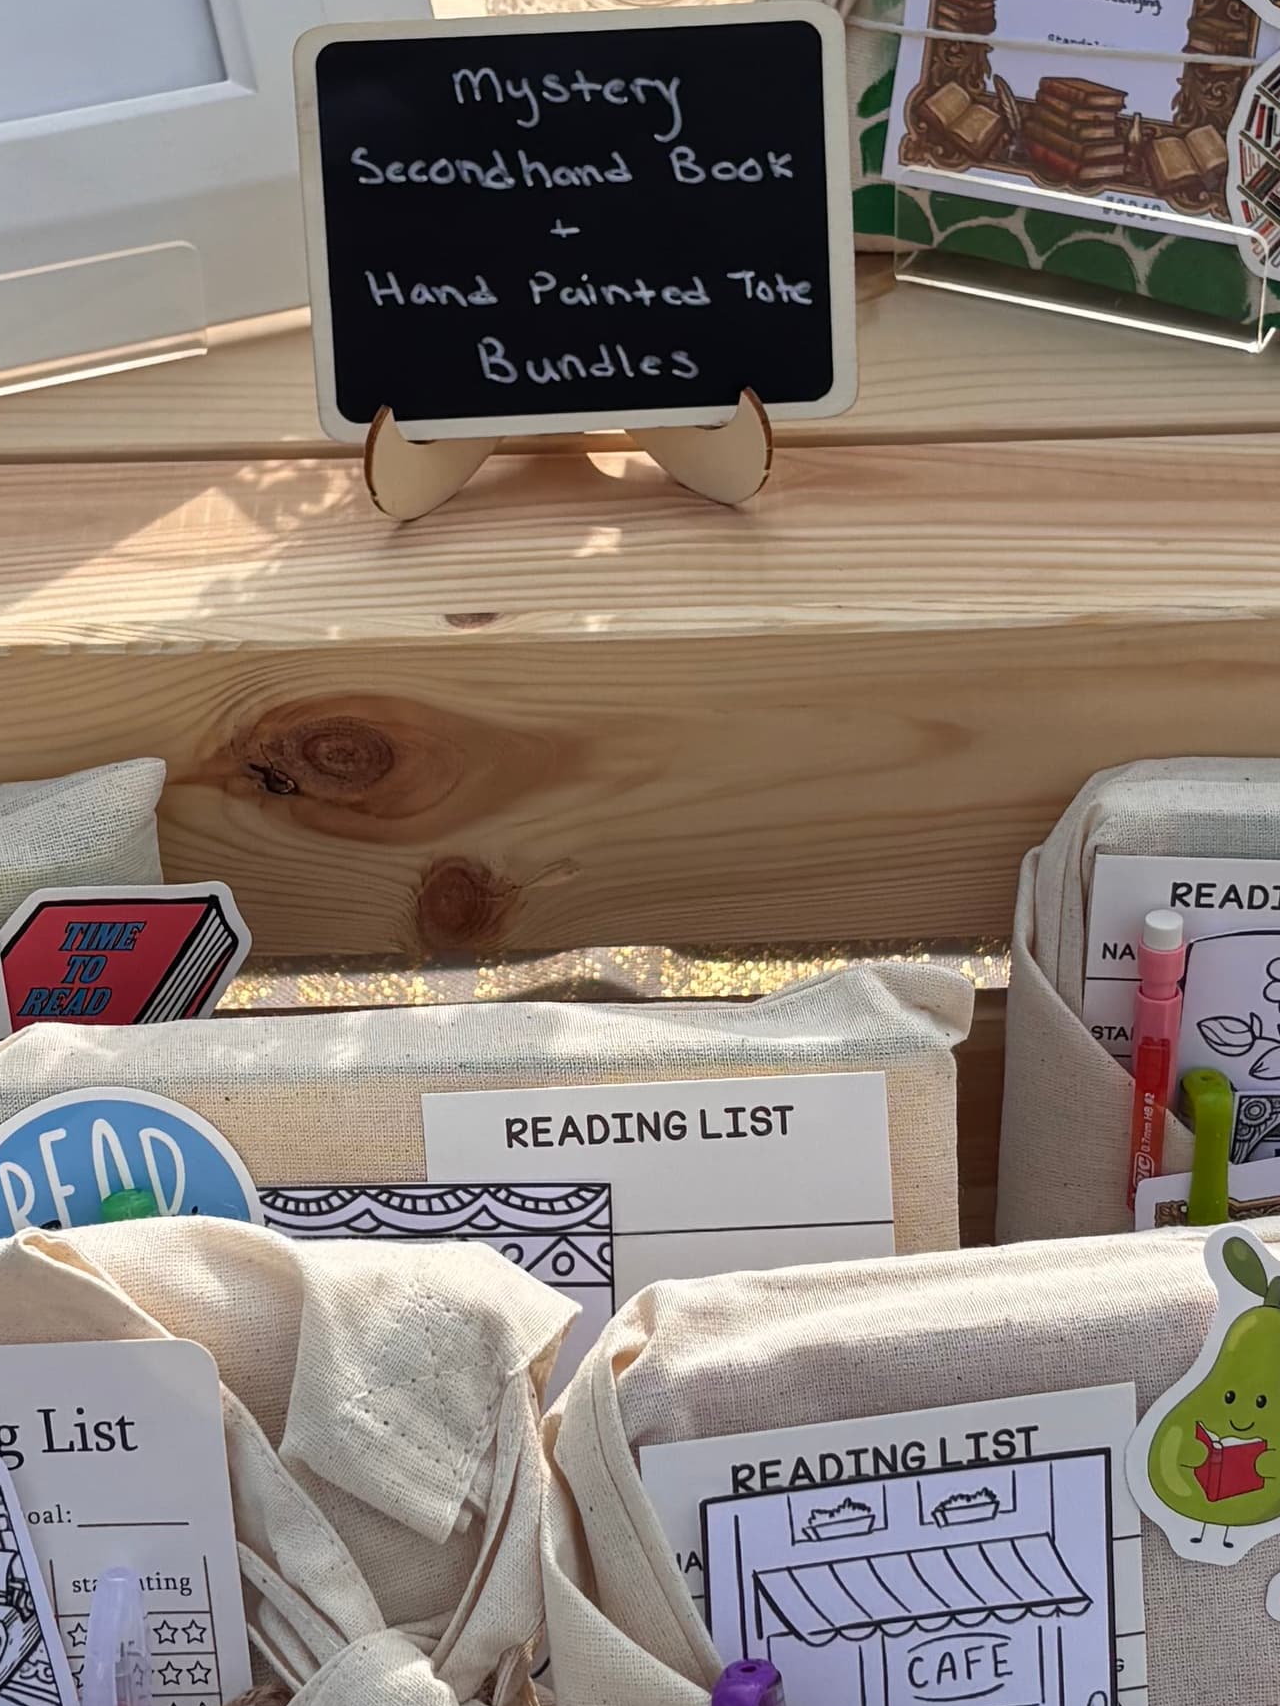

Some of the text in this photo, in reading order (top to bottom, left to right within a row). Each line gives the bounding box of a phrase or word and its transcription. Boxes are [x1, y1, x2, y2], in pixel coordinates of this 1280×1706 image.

[452, 66, 682, 143] Mystery
[350, 145, 795, 191] Secondhand Book
[364, 270, 814, 307] Hand Painted Tote
[477, 335, 699, 384] Bundles
[60, 921, 147, 951] TIME
[63, 955, 108, 984] TO
[17, 988, 113, 1017] READ
[503, 1103, 796, 1151] READING LIST
[36, 1407, 138, 1454] List
[731, 1425, 1040, 1494] READING LIST
[907, 1643, 1014, 1689] CAFE
